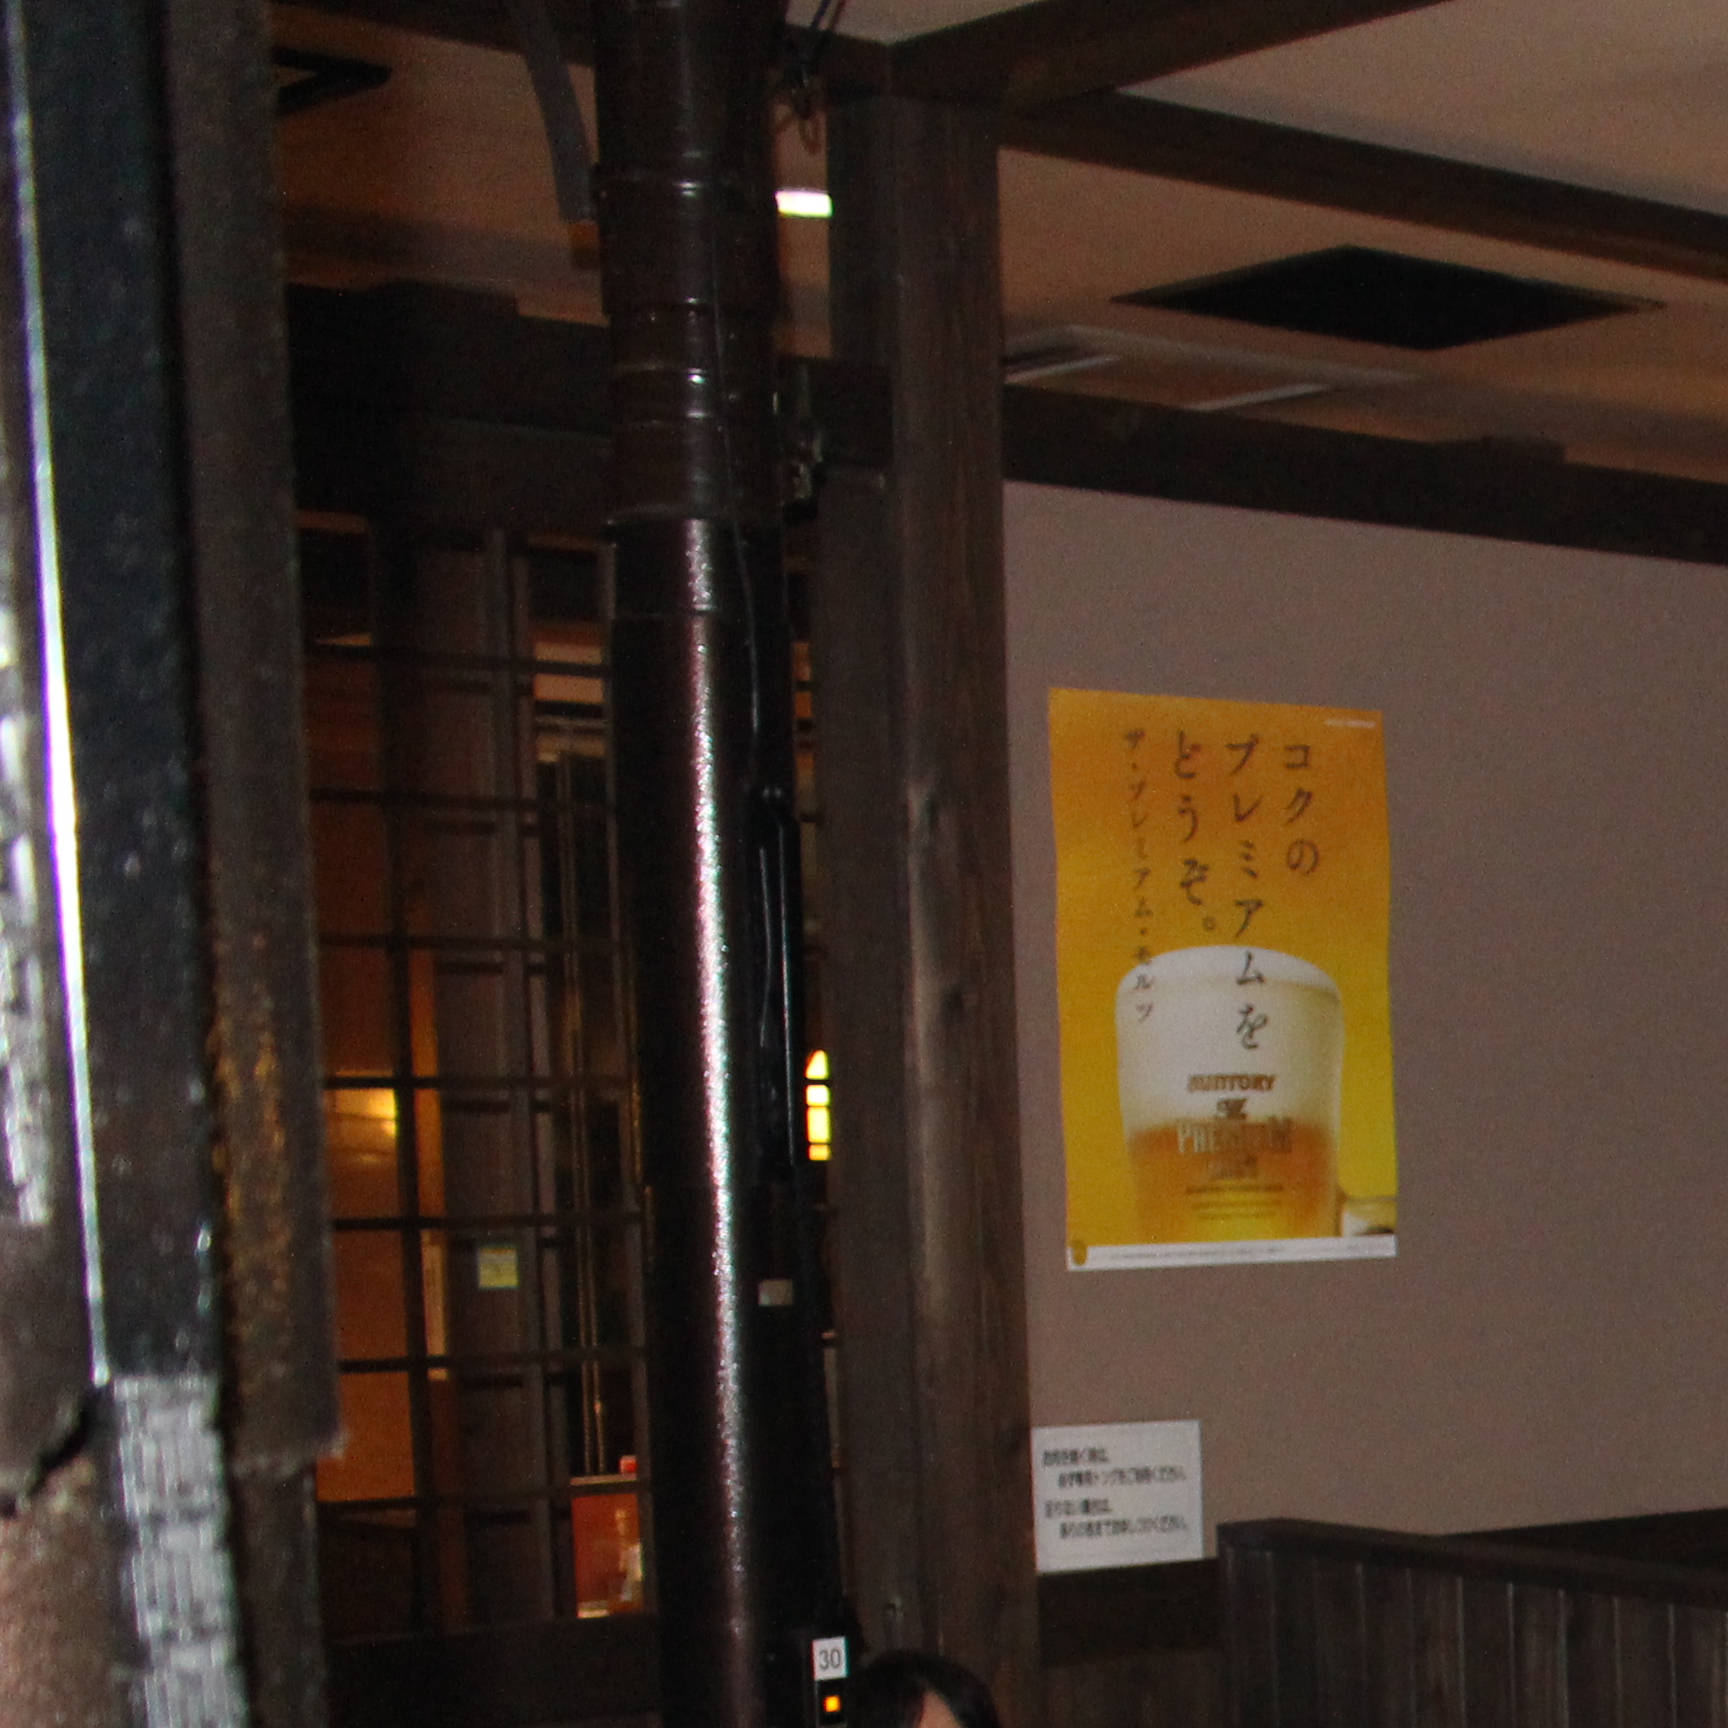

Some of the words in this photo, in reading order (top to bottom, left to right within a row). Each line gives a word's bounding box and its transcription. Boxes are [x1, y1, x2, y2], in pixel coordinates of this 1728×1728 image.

[1174, 730, 1217, 933] どうぞ。
[1224, 733, 1268, 1050] プレミアムを
[1285, 744, 1319, 875] コクの
[818, 1648, 842, 1672] 30
